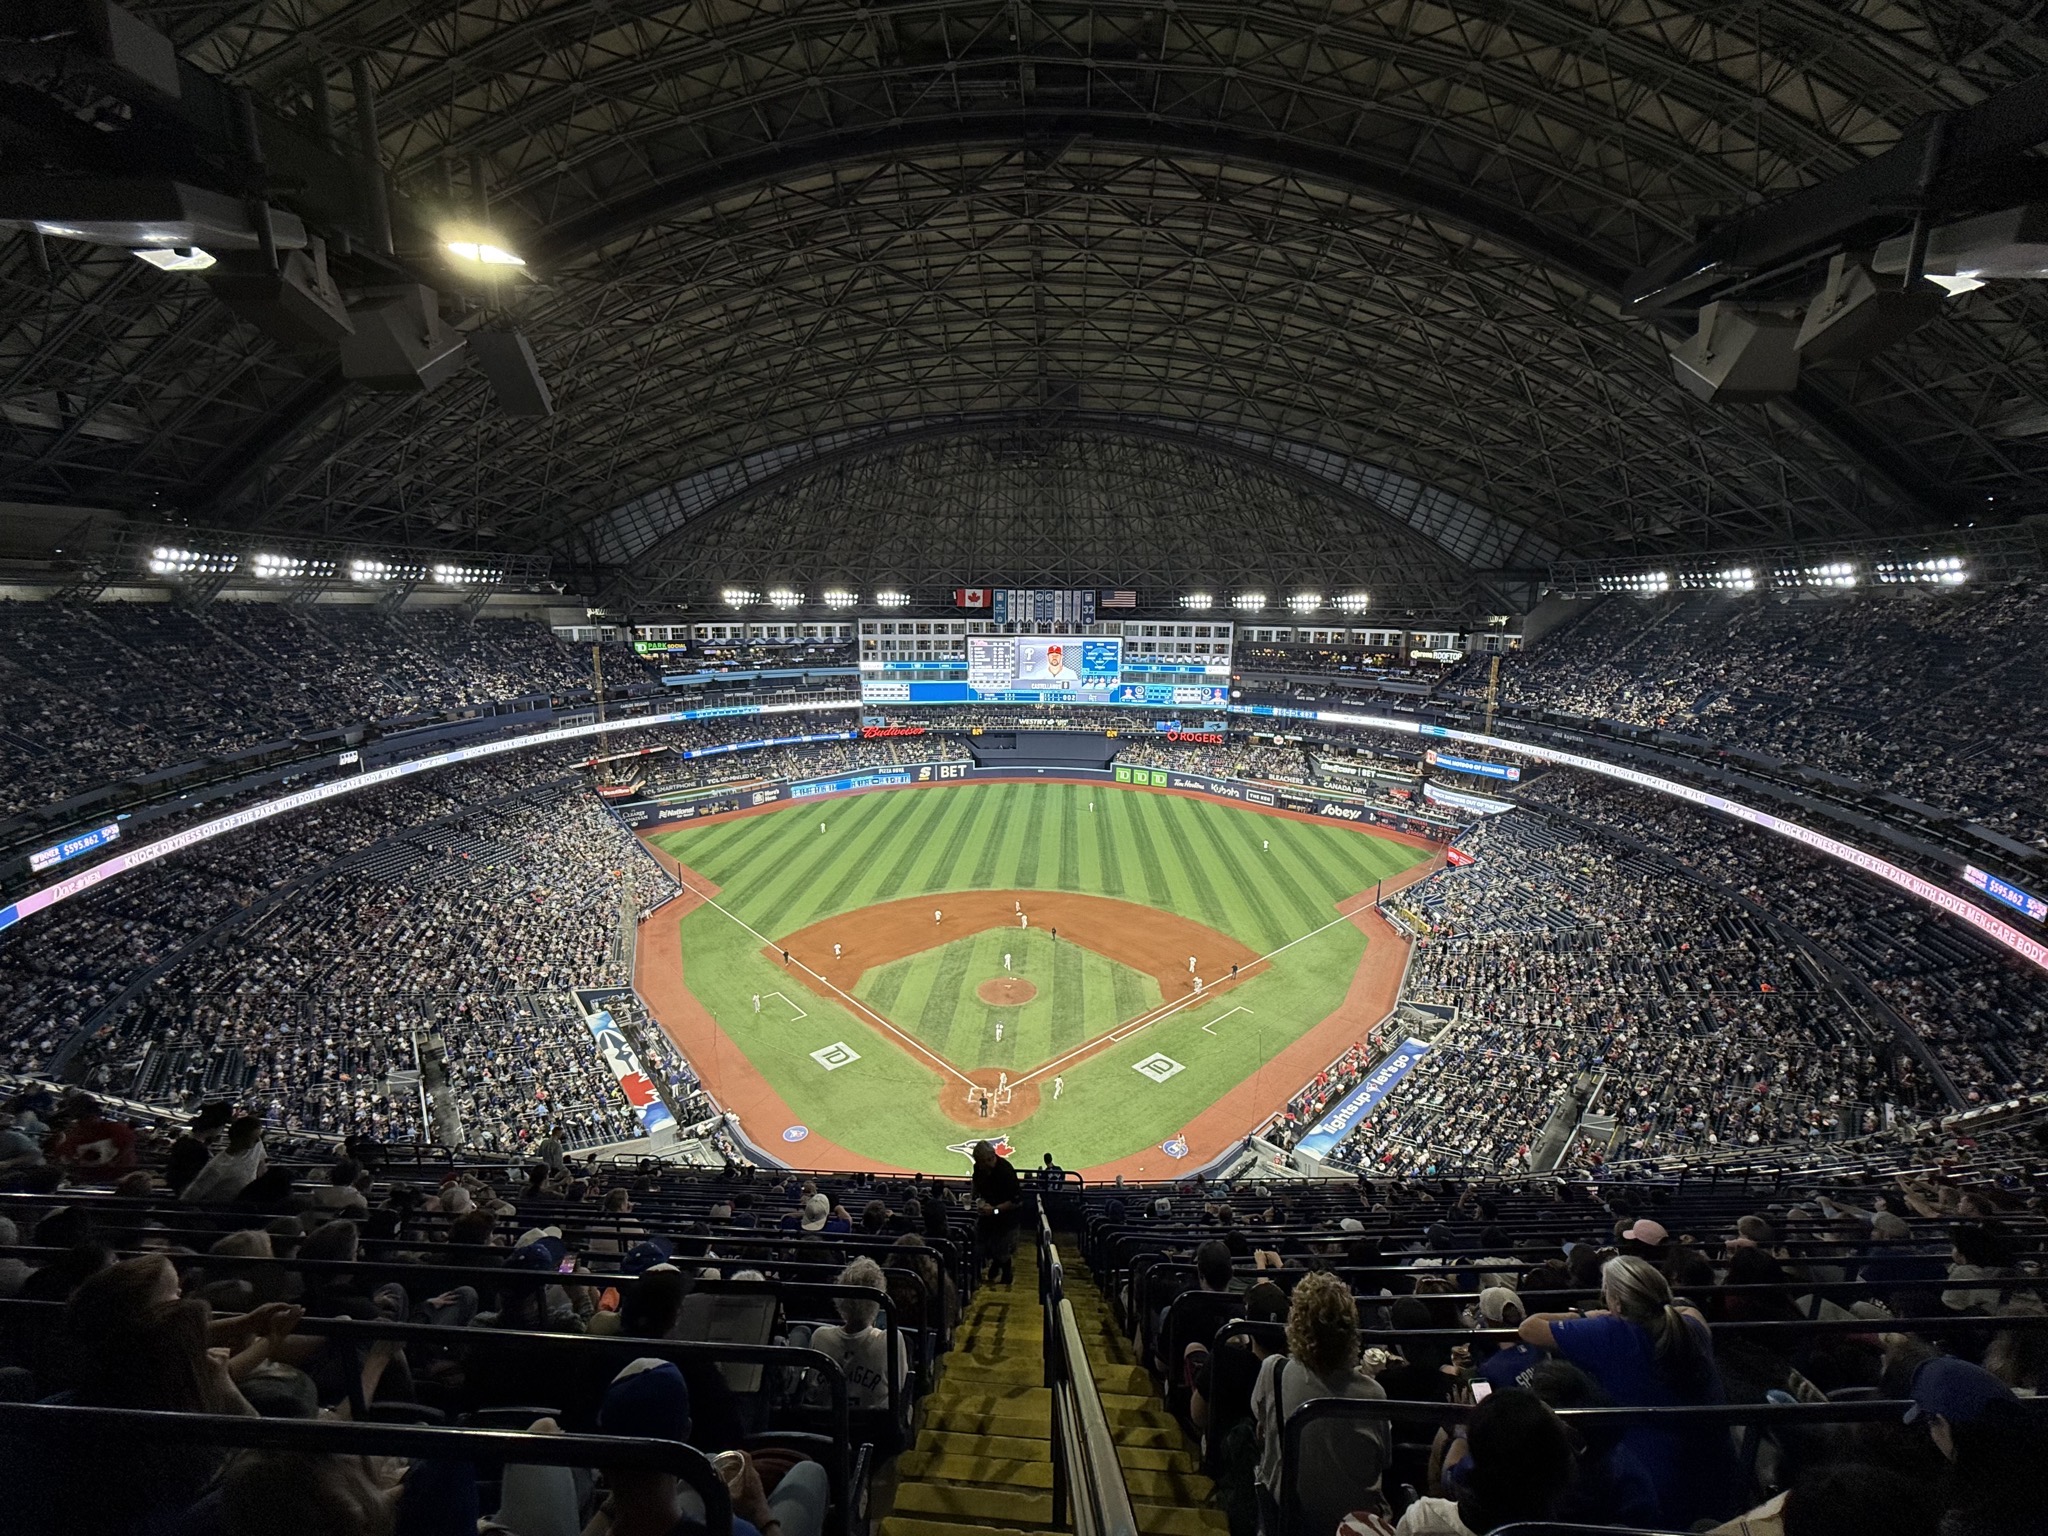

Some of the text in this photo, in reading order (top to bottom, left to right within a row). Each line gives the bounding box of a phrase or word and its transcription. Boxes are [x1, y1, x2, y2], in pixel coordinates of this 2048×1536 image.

[1083, 606, 1094, 614] 32
[1433, 652, 1462, 660] ROOFTOP
[861, 726, 925, 738] Budweiser
[1180, 732, 1223, 744] ROGERS
[940, 765, 967, 778] BET
[1321, 763, 1357, 774] theScore
[1362, 769, 1376, 778] BET
[1268, 774, 1304, 785] BLEACHERS
[657, 781, 697, 793] SMARTPHONE
[1211, 783, 1240, 798] Kubota
[1324, 782, 1367, 795] CANADA DRY
[668, 806, 695, 817] National
[1321, 804, 1361, 820] Sobeys
[124, 846, 160, 868] KNOCK
[161, 830, 201, 853] DRYNESS
[203, 823, 221, 836] OUT
[224, 819, 236, 829] OF
[236, 813, 254, 825] THE
[255, 806, 275, 818] PARK
[276, 798, 298, 811] WITH
[299, 792, 320, 804] DOVE
[1774, 820, 1802, 838] KNOCK
[1802, 831, 1838, 853] DRYNESS
[1839, 847, 1857, 861] OUT
[1858, 855, 1871, 867] OF
[1871, 861, 1889, 877] THE
[1890, 869, 1912, 891] PARK
[1913, 880, 1937, 899] WITH
[1938, 892, 1966, 915] DOVE
[2017, 936, 2045, 963] BODY
[822, 1046, 850, 1064] TD
[1140, 1058, 1174, 1075] TD
[1322, 1104, 1358, 1134] lights
[1372, 1066, 1398, 1086] let's
